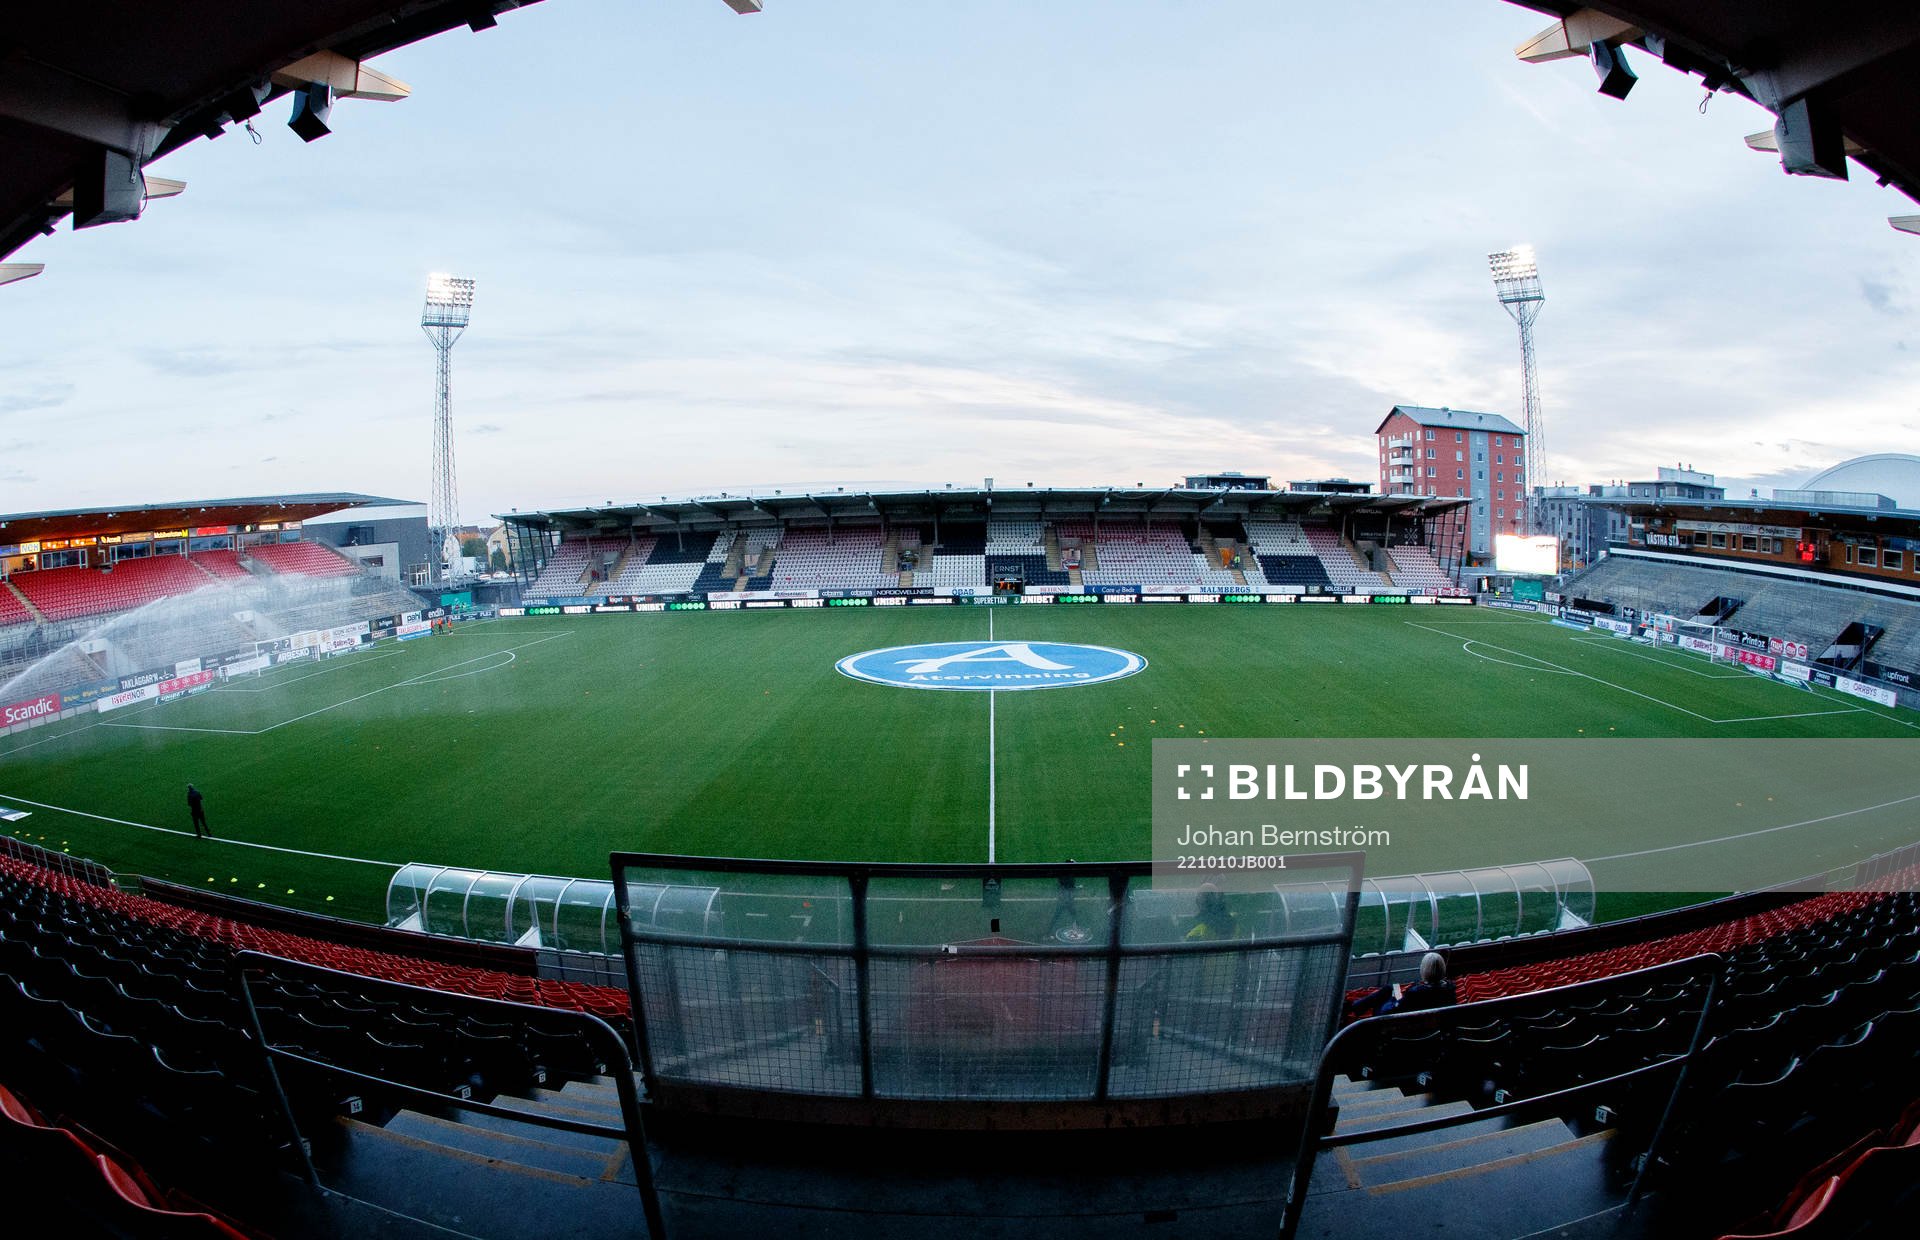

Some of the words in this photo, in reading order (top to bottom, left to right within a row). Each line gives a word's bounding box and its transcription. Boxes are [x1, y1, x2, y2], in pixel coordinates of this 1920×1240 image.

[1646, 531, 1668, 546] VÄSTRA
[792, 599, 824, 607] UNIBET
[873, 597, 907, 605] UNIBET
[1021, 595, 1054, 603] UNIBET
[1342, 595, 1371, 603] UNIBET
[1410, 596, 1437, 604] UNIBET
[636, 603, 665, 611] UNIBET
[710, 601, 741, 609] UNIBET
[500, 608, 525, 616] UNIBET
[277, 648, 310, 663] ARBESKO
[1887, 671, 1909, 683] upfront
[5, 698, 54, 723] Scandic
